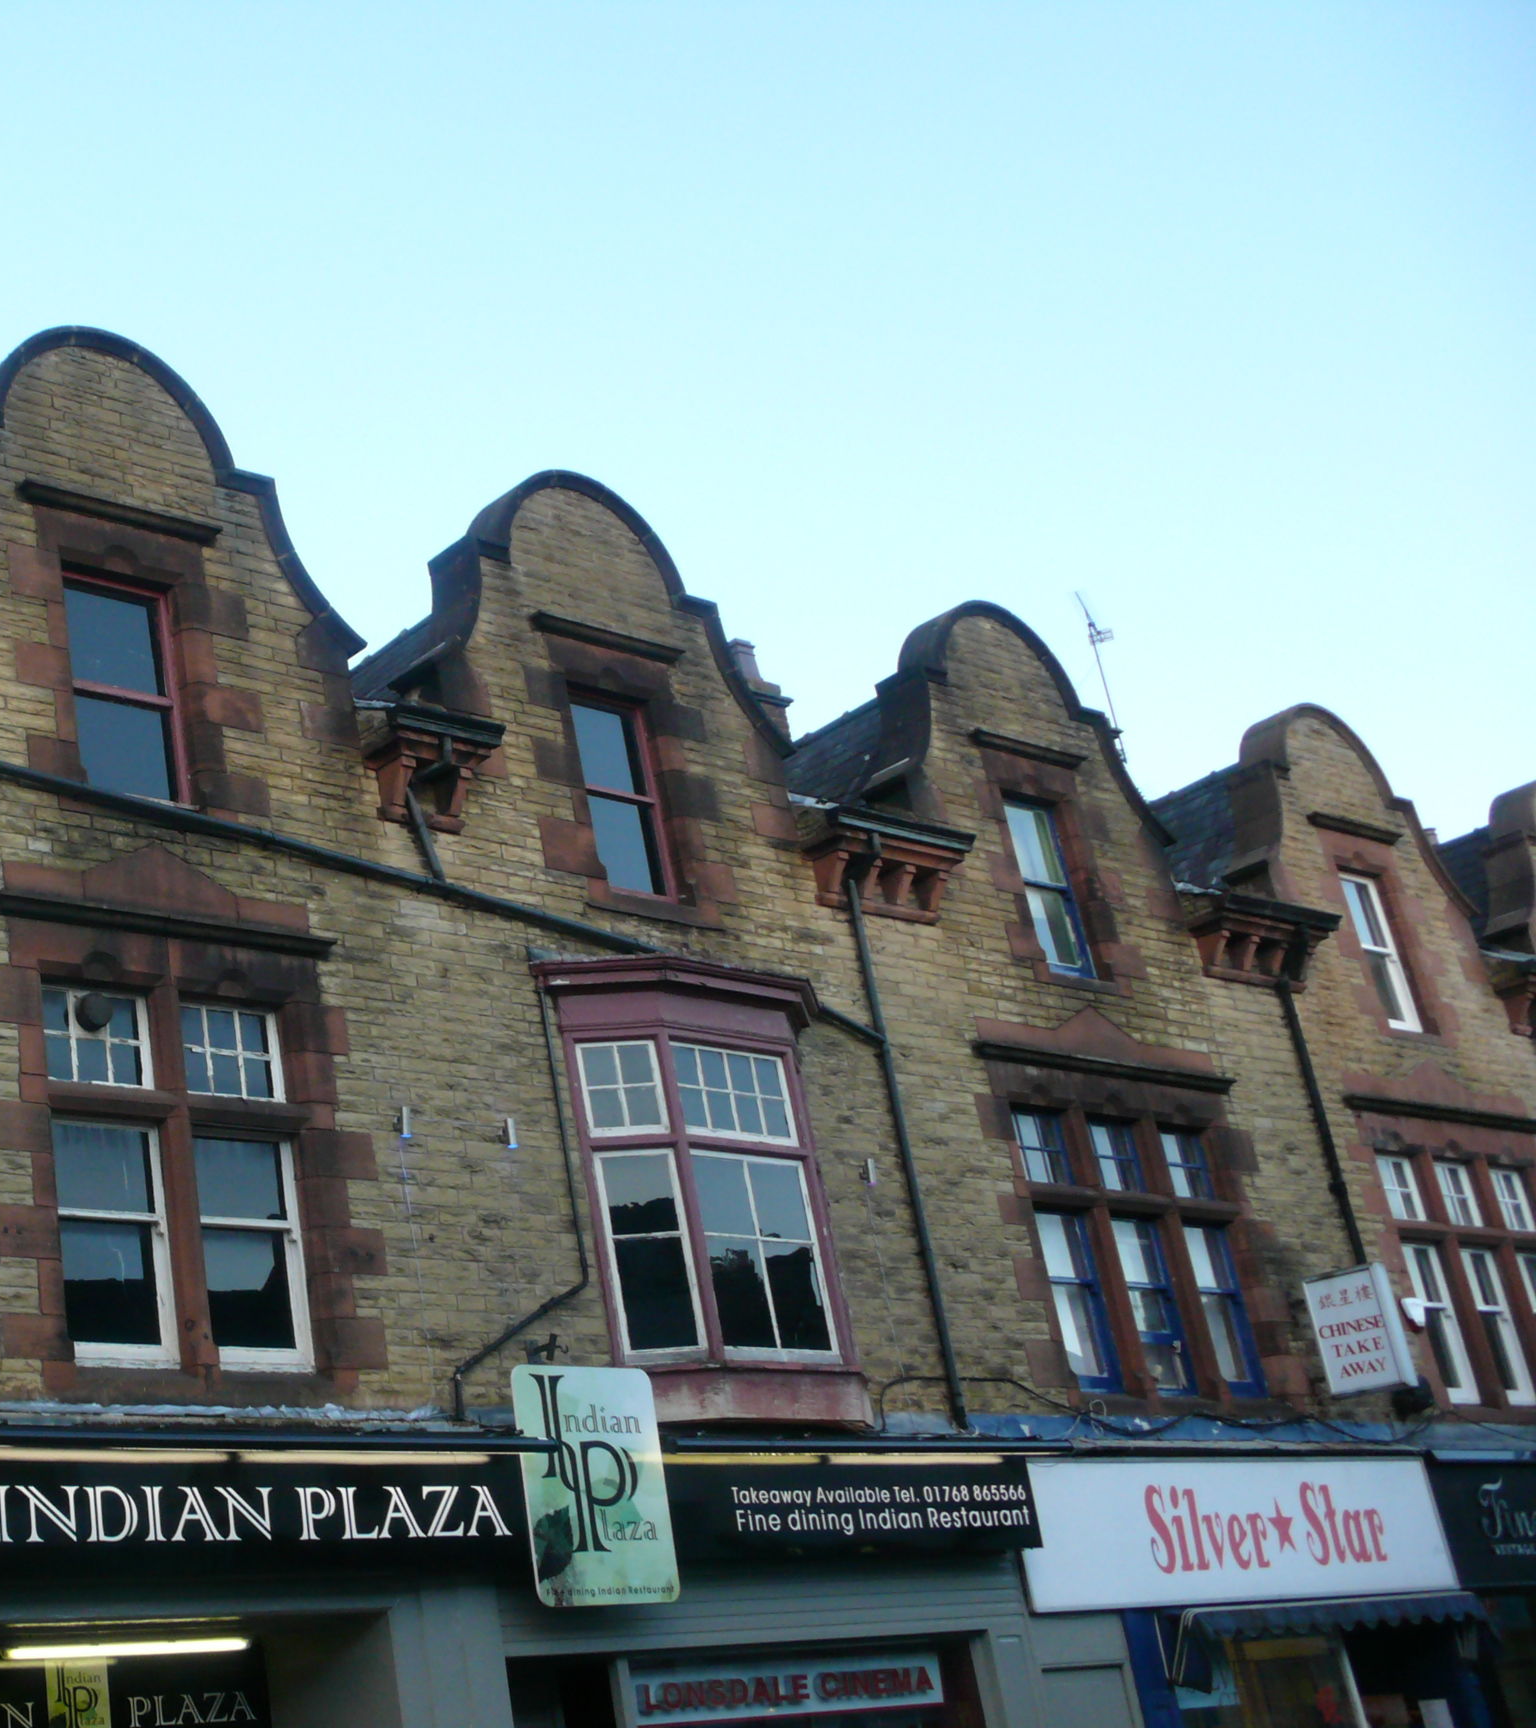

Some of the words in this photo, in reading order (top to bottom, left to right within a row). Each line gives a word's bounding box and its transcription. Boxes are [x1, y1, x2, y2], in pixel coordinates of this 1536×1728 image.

[1319, 1314, 1385, 1339] CHINESE
[1331, 1336, 1385, 1358] TAKE
[1340, 1357, 1386, 1379] AWAY
[731, 1486, 812, 1507] Takeaway
[816, 1486, 891, 1504] Available
[892, 1486, 920, 1504] Tel.
[923, 1485, 969, 1503] 01768
[973, 1484, 1026, 1501] 865566
[295, 1484, 513, 1541] PLAZA
[735, 1509, 782, 1532] Fine
[787, 1509, 854, 1536] dining
[859, 1508, 924, 1530] Indian
[927, 1505, 1031, 1529] Restaurant
[1144, 1484, 1271, 1574] Silver
[1299, 1481, 1388, 1566] Star
[640, 1674, 811, 1712] LONSDALE
[818, 1665, 935, 1699] CINEMA
[127, 1691, 257, 1728] PLAZA
